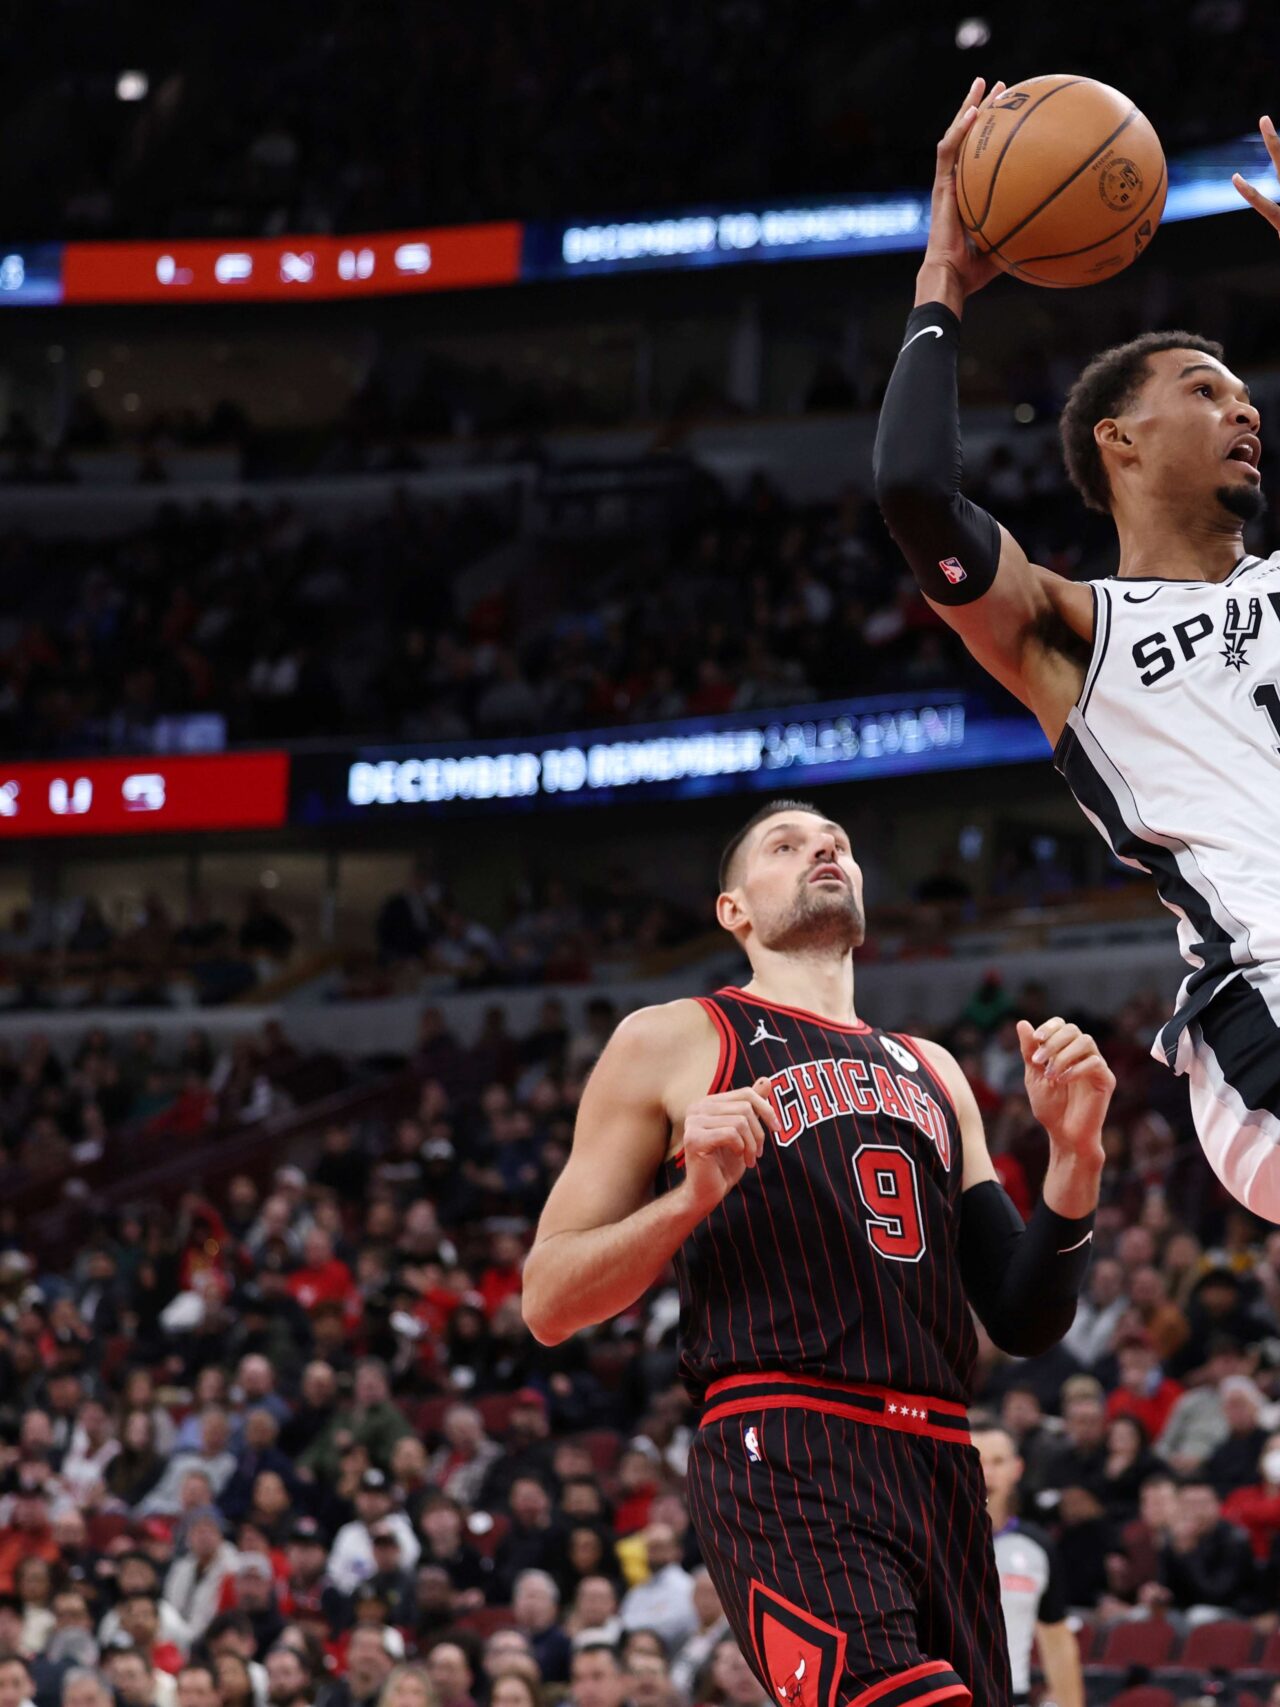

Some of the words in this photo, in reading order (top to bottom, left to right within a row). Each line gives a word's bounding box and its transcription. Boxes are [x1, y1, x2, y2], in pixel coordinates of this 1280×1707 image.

[350, 754, 540, 804] DECEMBER
[588, 729, 763, 787] REMEMBER
[767, 1058, 951, 1173] CHICAGO
[852, 1143, 926, 1263] 9
